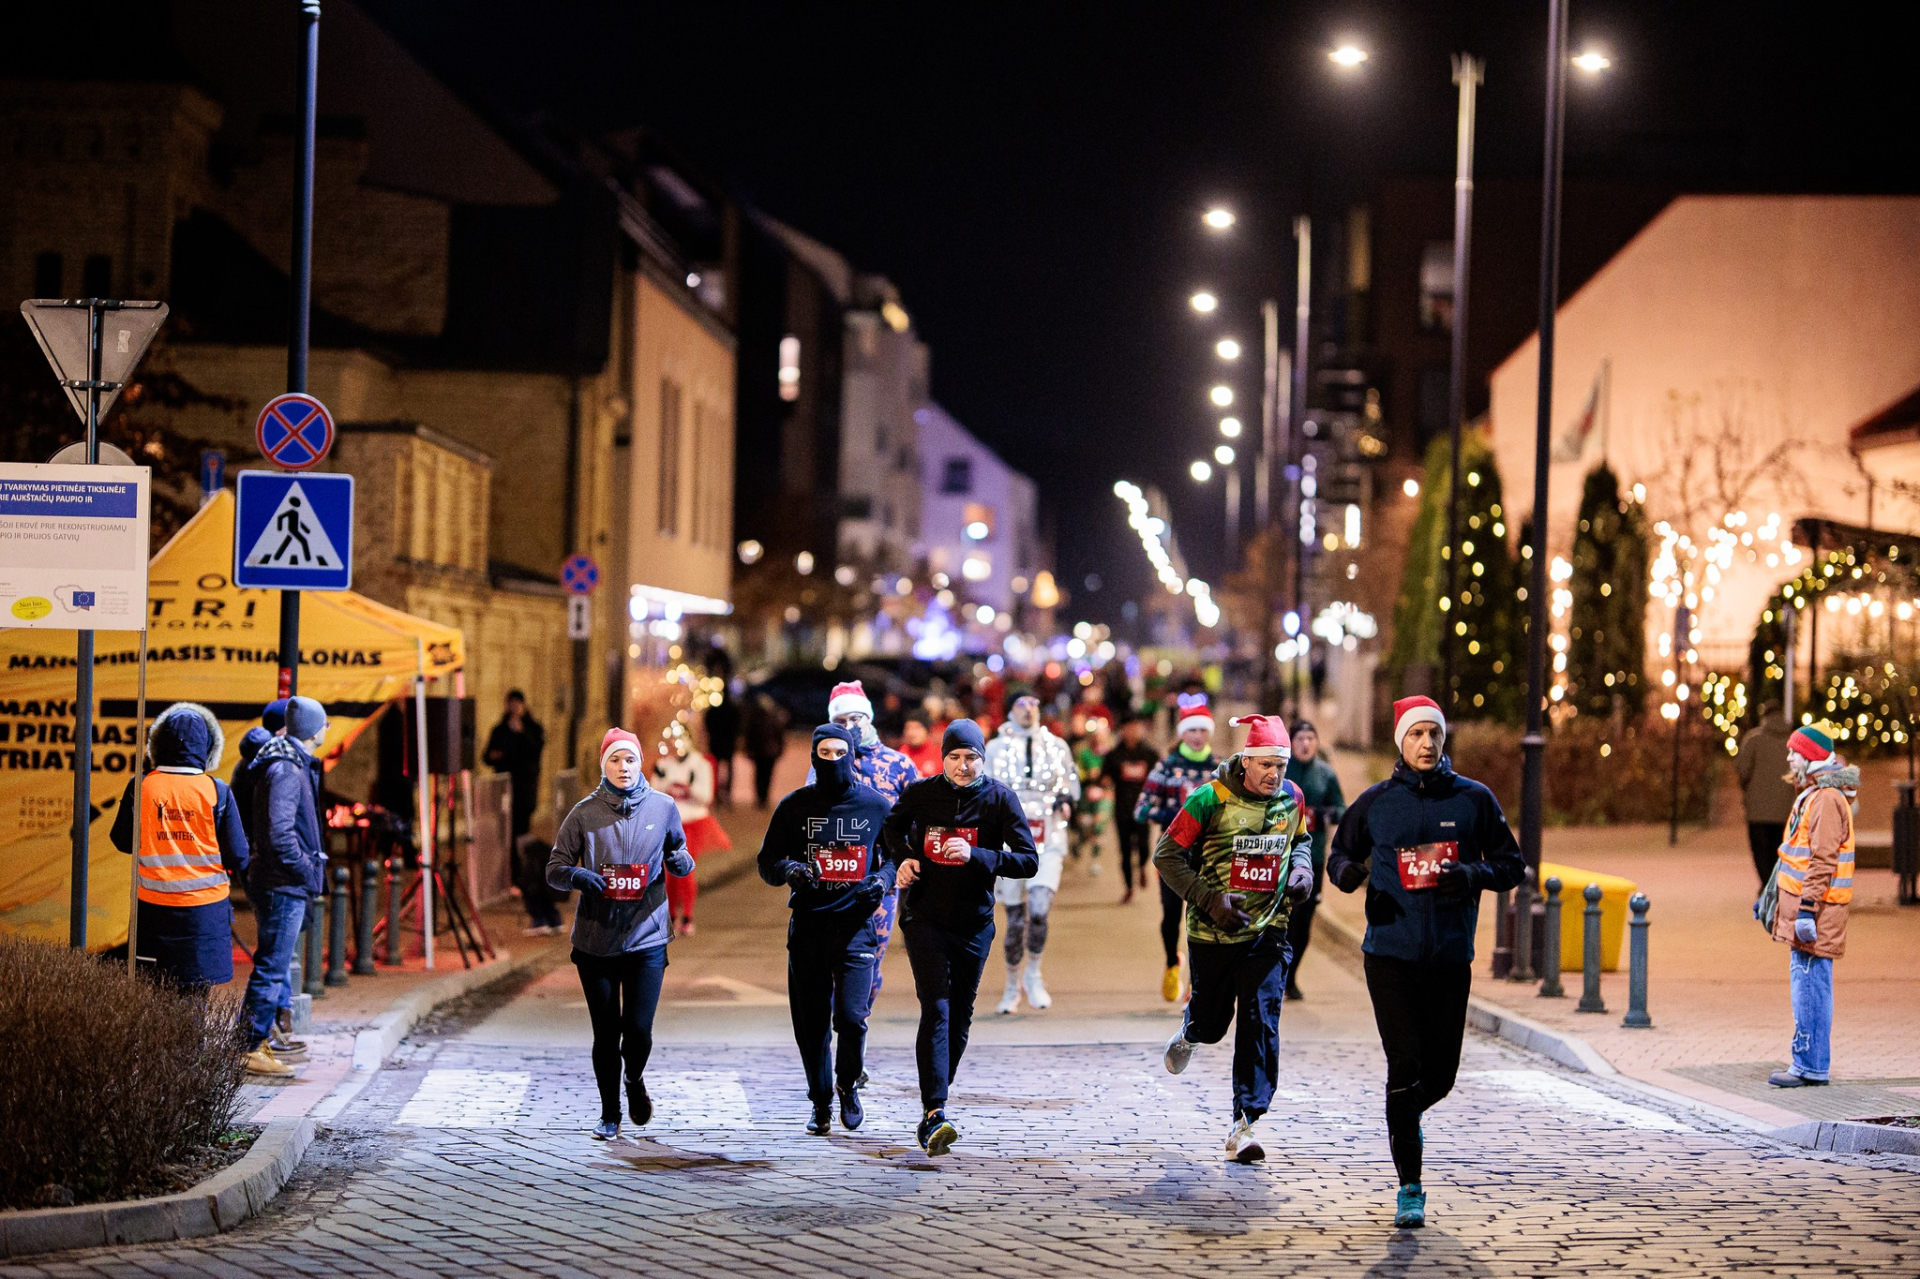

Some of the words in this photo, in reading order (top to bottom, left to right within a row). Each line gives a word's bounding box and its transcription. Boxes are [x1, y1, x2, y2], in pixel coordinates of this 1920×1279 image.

[4, 483, 50, 492] TVARKYMAS
[51, 484, 86, 493] PIETINĖJE
[87, 484, 126, 494] TIKSLINĖJE
[11, 493, 54, 504] AUKŠTAIČIŲ
[55, 495, 84, 503] PAUPIO
[16, 522, 39, 530] ERDVĖ
[58, 523, 128, 533] REKONSTRUOJAMŲ
[53, 533, 80, 542] GATVIŲ
[148, 598, 255, 617] TRI
[221, 646, 382, 667] TRIALONAS
[825, 859, 858, 871] 3919
[1239, 867, 1273, 881] 4021
[608, 877, 641, 890] 3918
